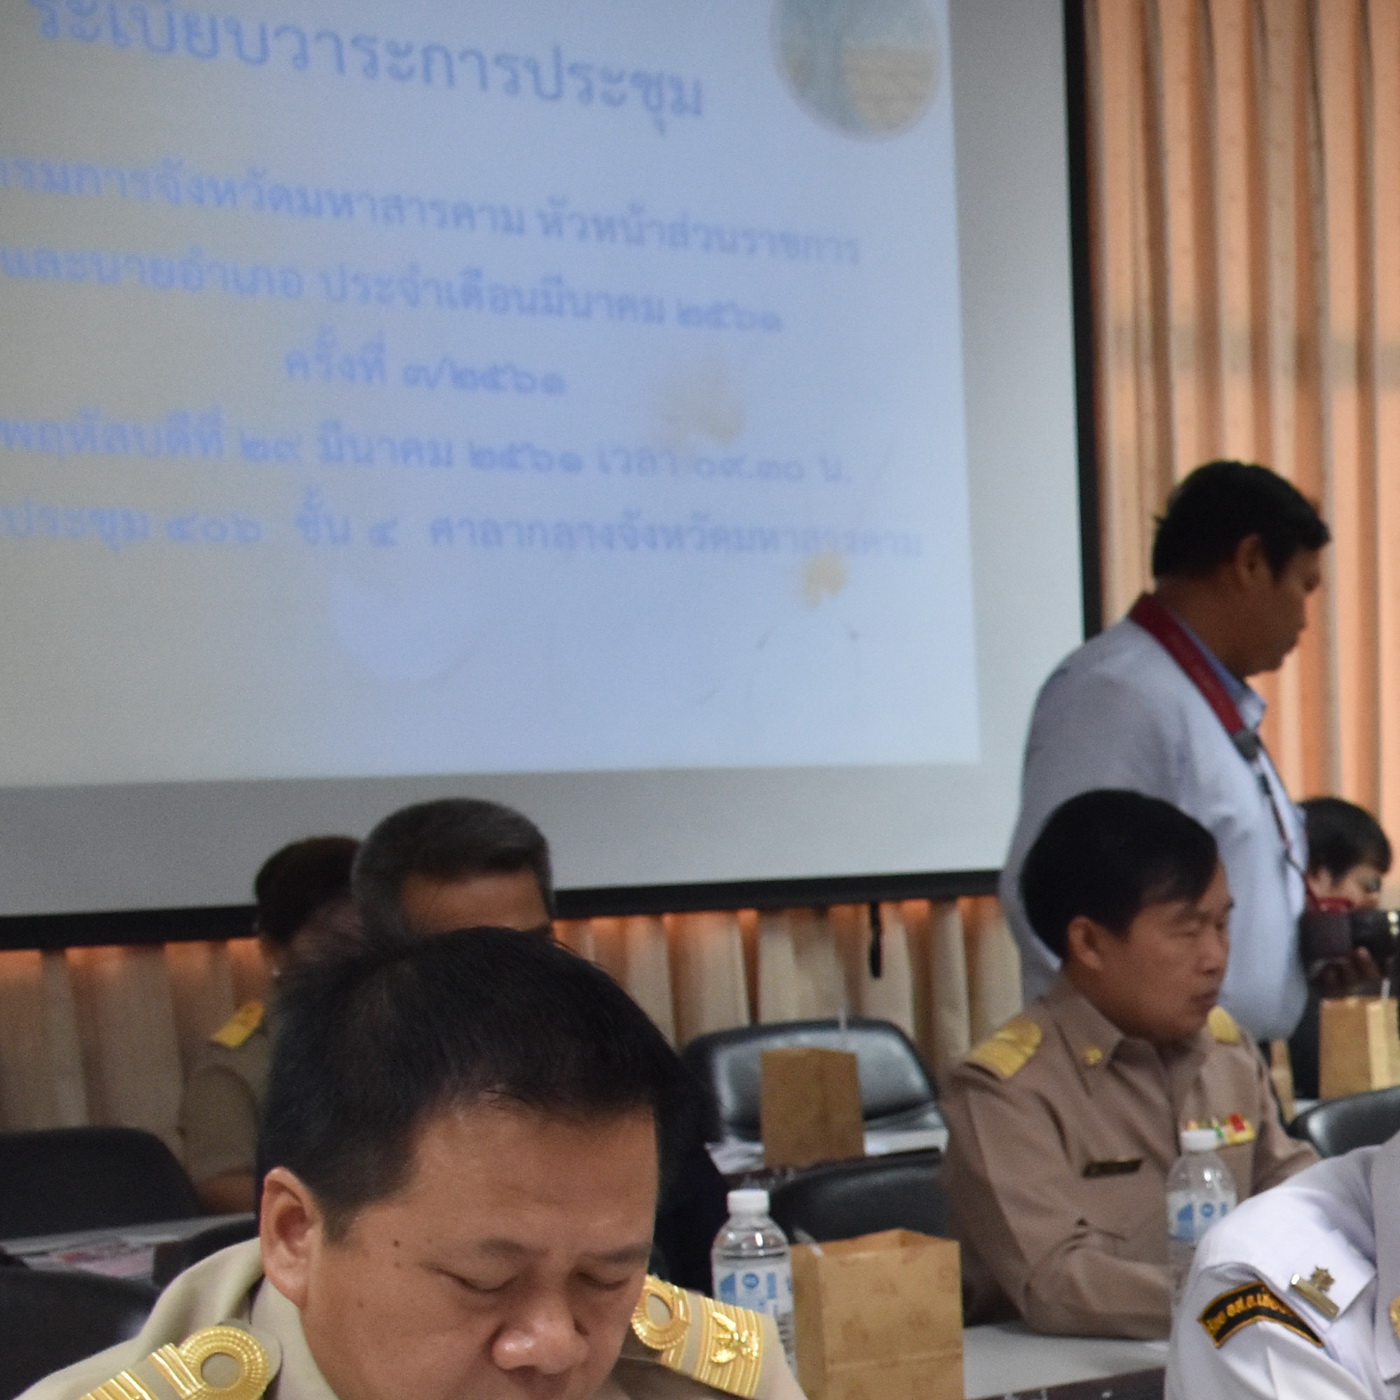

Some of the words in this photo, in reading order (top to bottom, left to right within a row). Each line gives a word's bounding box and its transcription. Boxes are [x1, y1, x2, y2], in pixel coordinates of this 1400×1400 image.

[27, 0, 703, 137] ระเบยบวาระการประชุม
